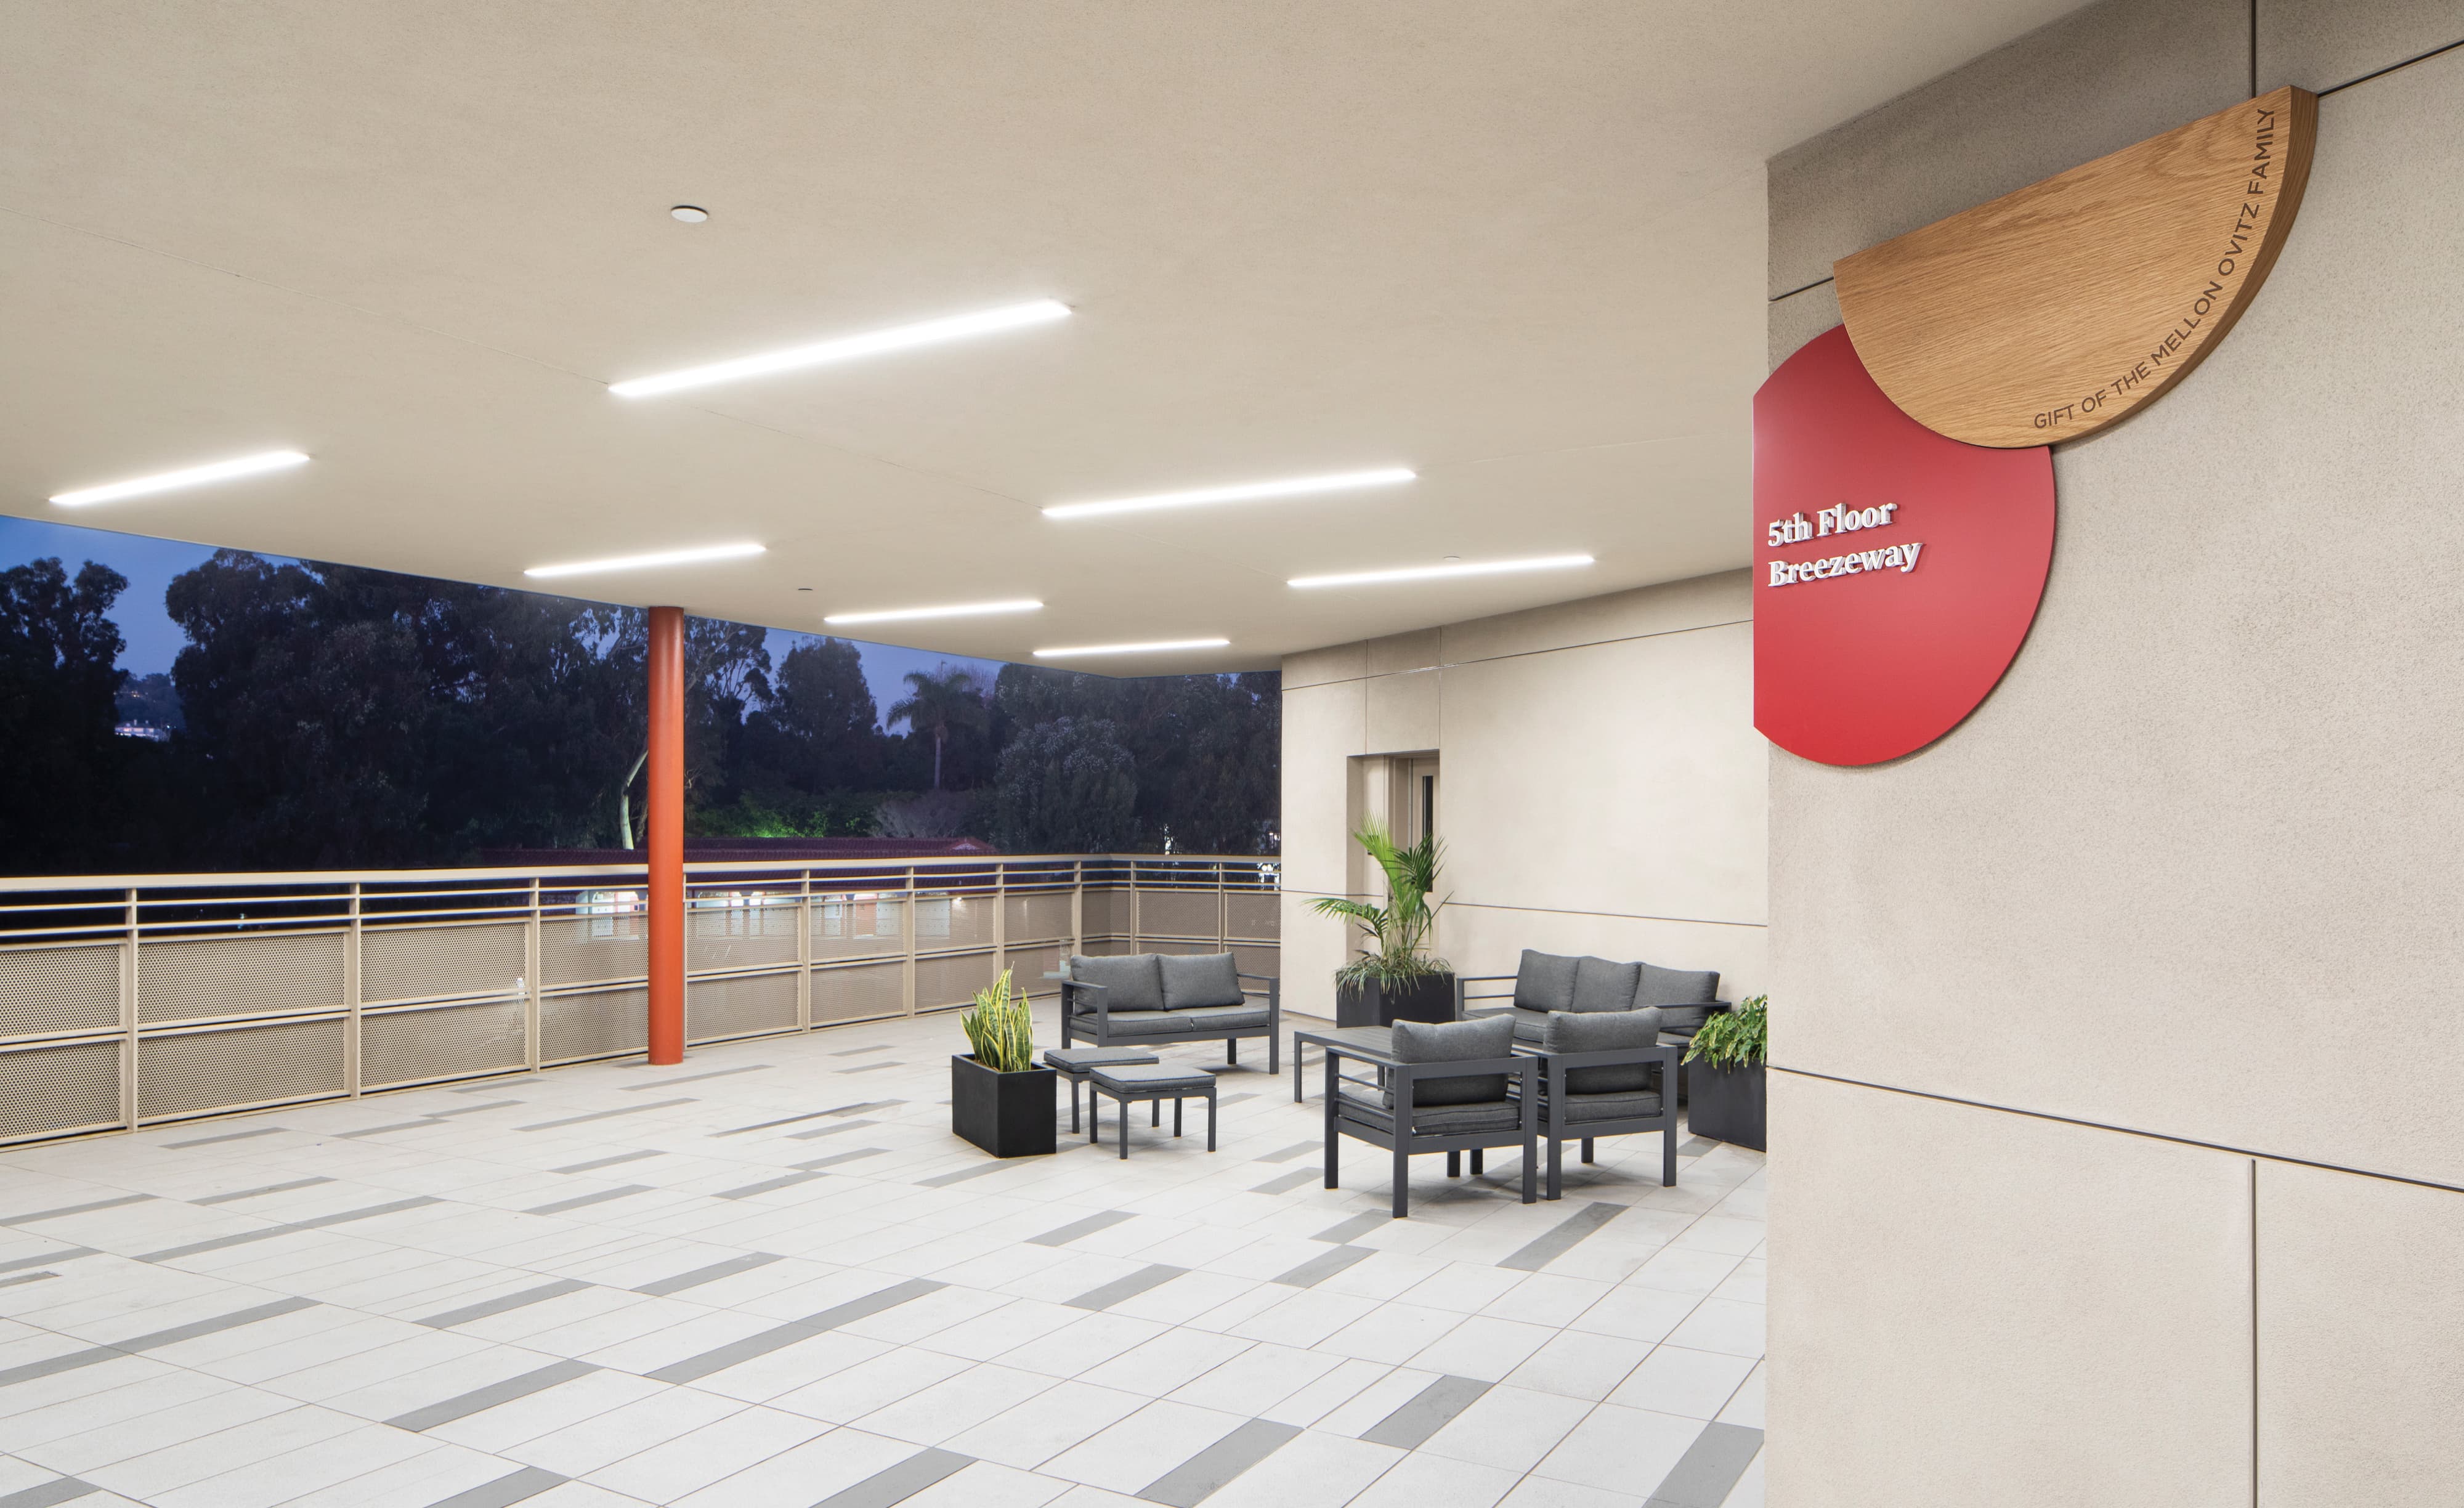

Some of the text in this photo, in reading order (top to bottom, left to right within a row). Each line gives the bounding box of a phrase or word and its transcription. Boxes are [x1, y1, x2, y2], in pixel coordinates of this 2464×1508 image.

[2034, 108, 2274, 429] GIFT OF THE MELLON OVITZ FAMILY
[1768, 503, 1897, 547] 5th Floor
[1768, 543, 1923, 586] Breezeway
